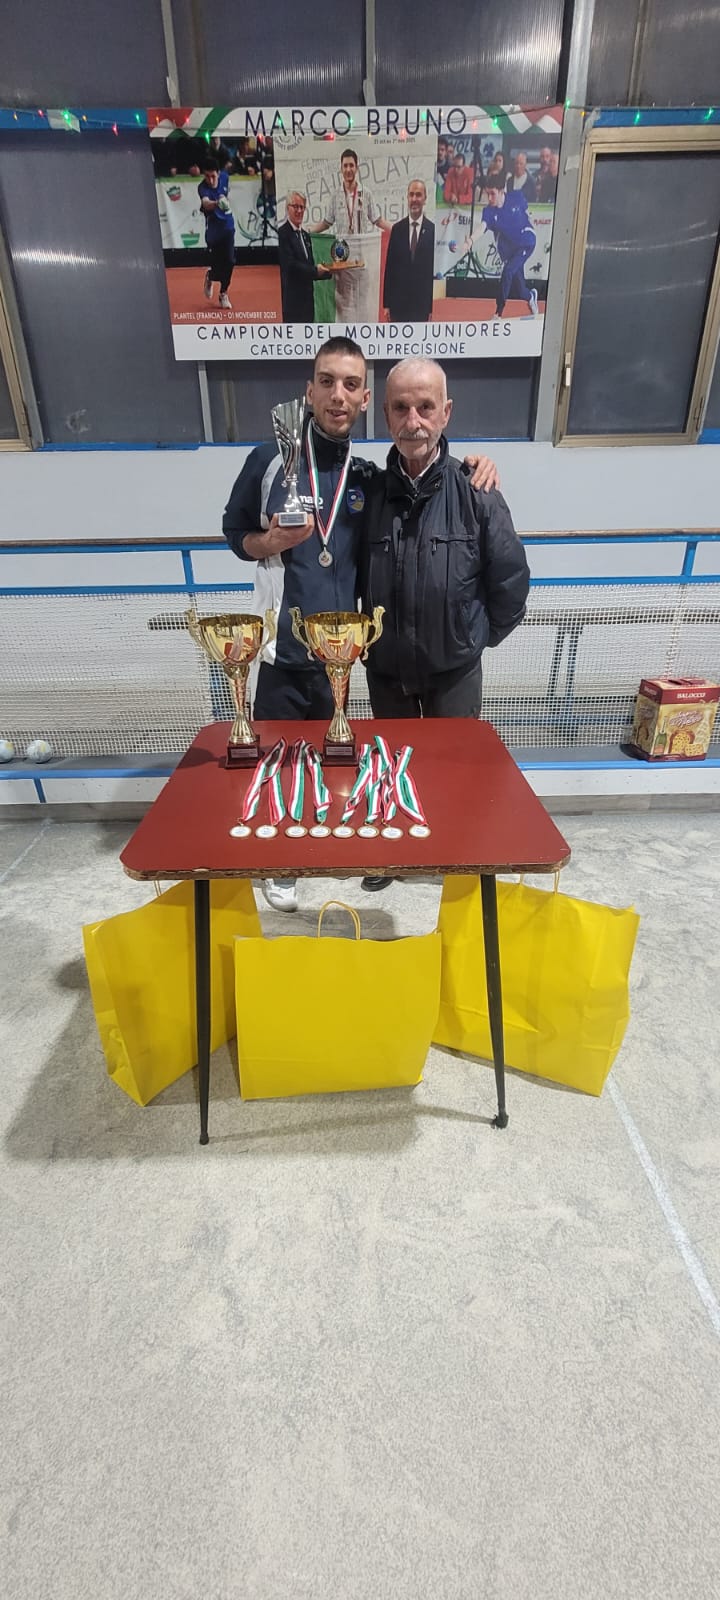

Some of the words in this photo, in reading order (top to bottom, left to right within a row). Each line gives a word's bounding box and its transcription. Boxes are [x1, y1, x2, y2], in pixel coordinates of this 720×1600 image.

[245, 109, 351, 137] MARCO
[367, 108, 467, 136] BRUNO
[173, 312, 195, 320] PLANTEL
[196, 312, 223, 320] (FRANCIA)
[197, 325, 294, 340] CAMPIONE
[304, 325, 334, 339] DEL
[345, 324, 414, 339] MONDO
[423, 322, 512, 341] JUNIORES
[250, 344, 316, 356] CATEGORI
[368, 343, 381, 355] DI
[386, 342, 466, 355] PRECISIONE
